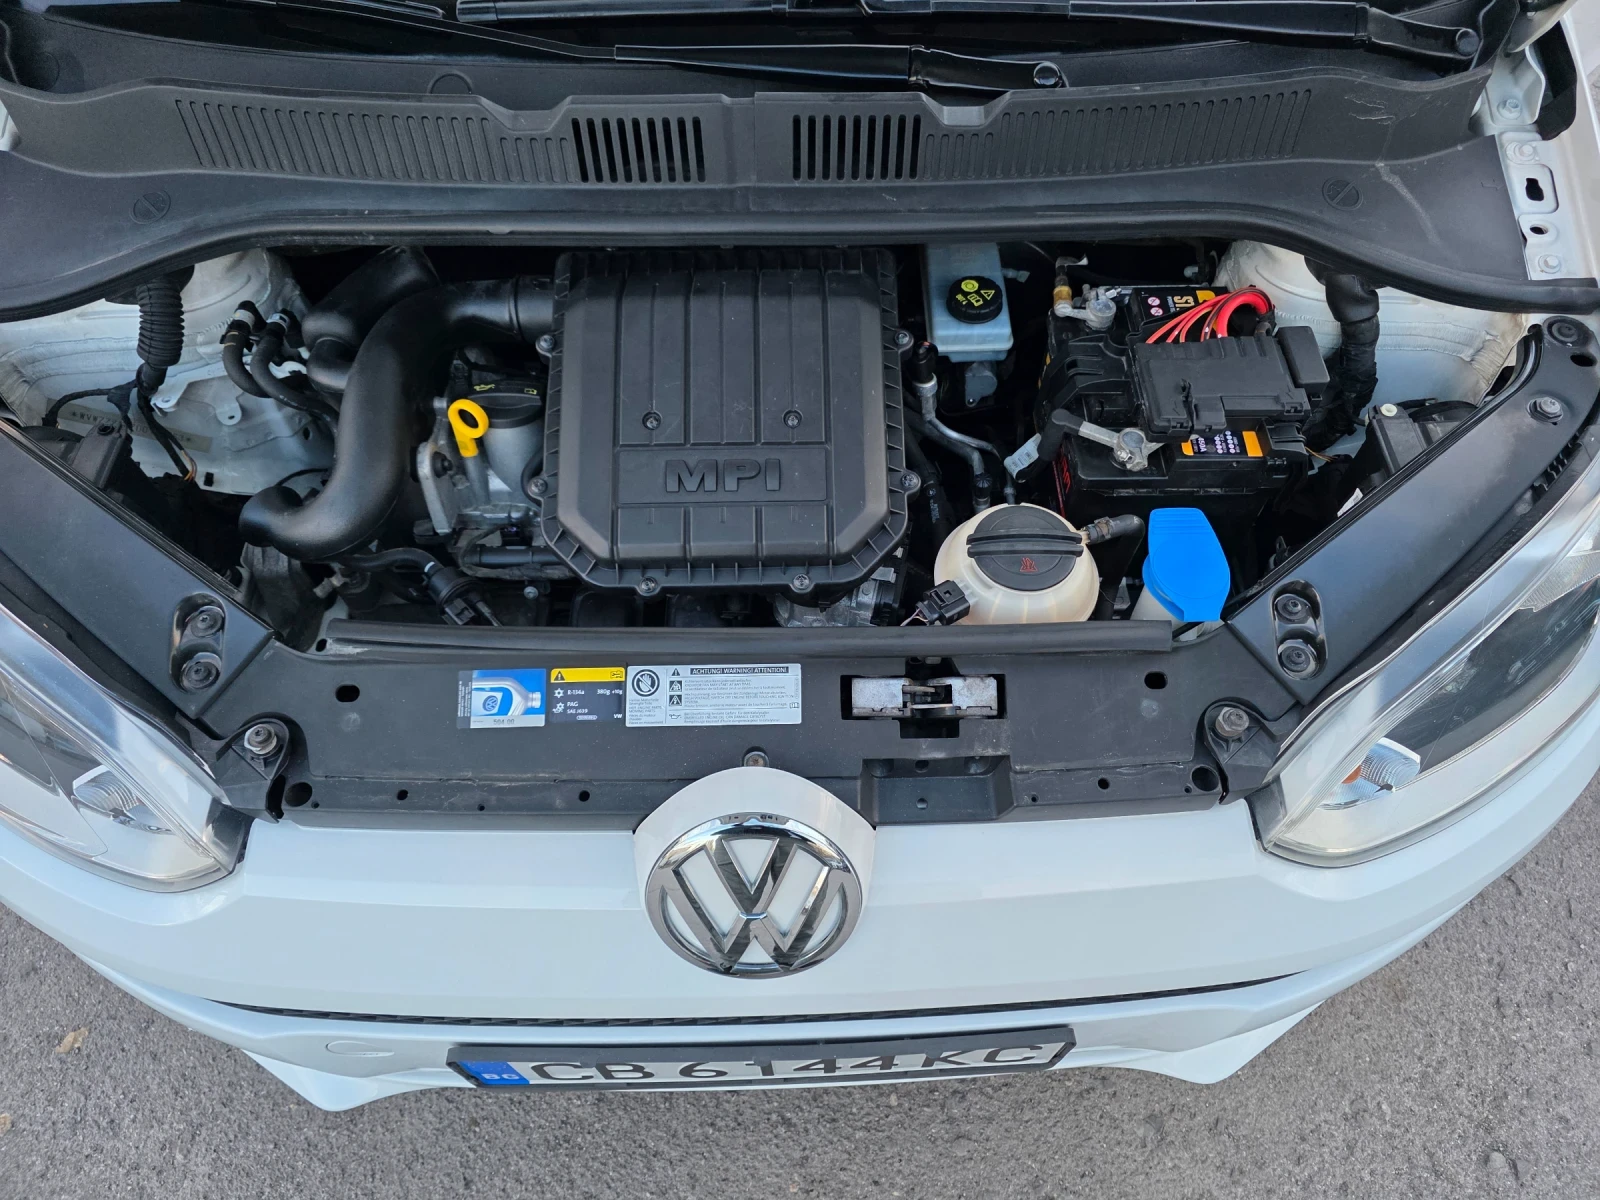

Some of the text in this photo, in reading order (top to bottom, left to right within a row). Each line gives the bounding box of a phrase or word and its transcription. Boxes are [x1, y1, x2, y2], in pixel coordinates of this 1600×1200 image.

[665, 458, 781, 493] MPI
[692, 668, 723, 676] ACHTUNG!
[723, 667, 752, 675] WARNING!
[531, 1045, 1043, 1080] CB 6144 KC
